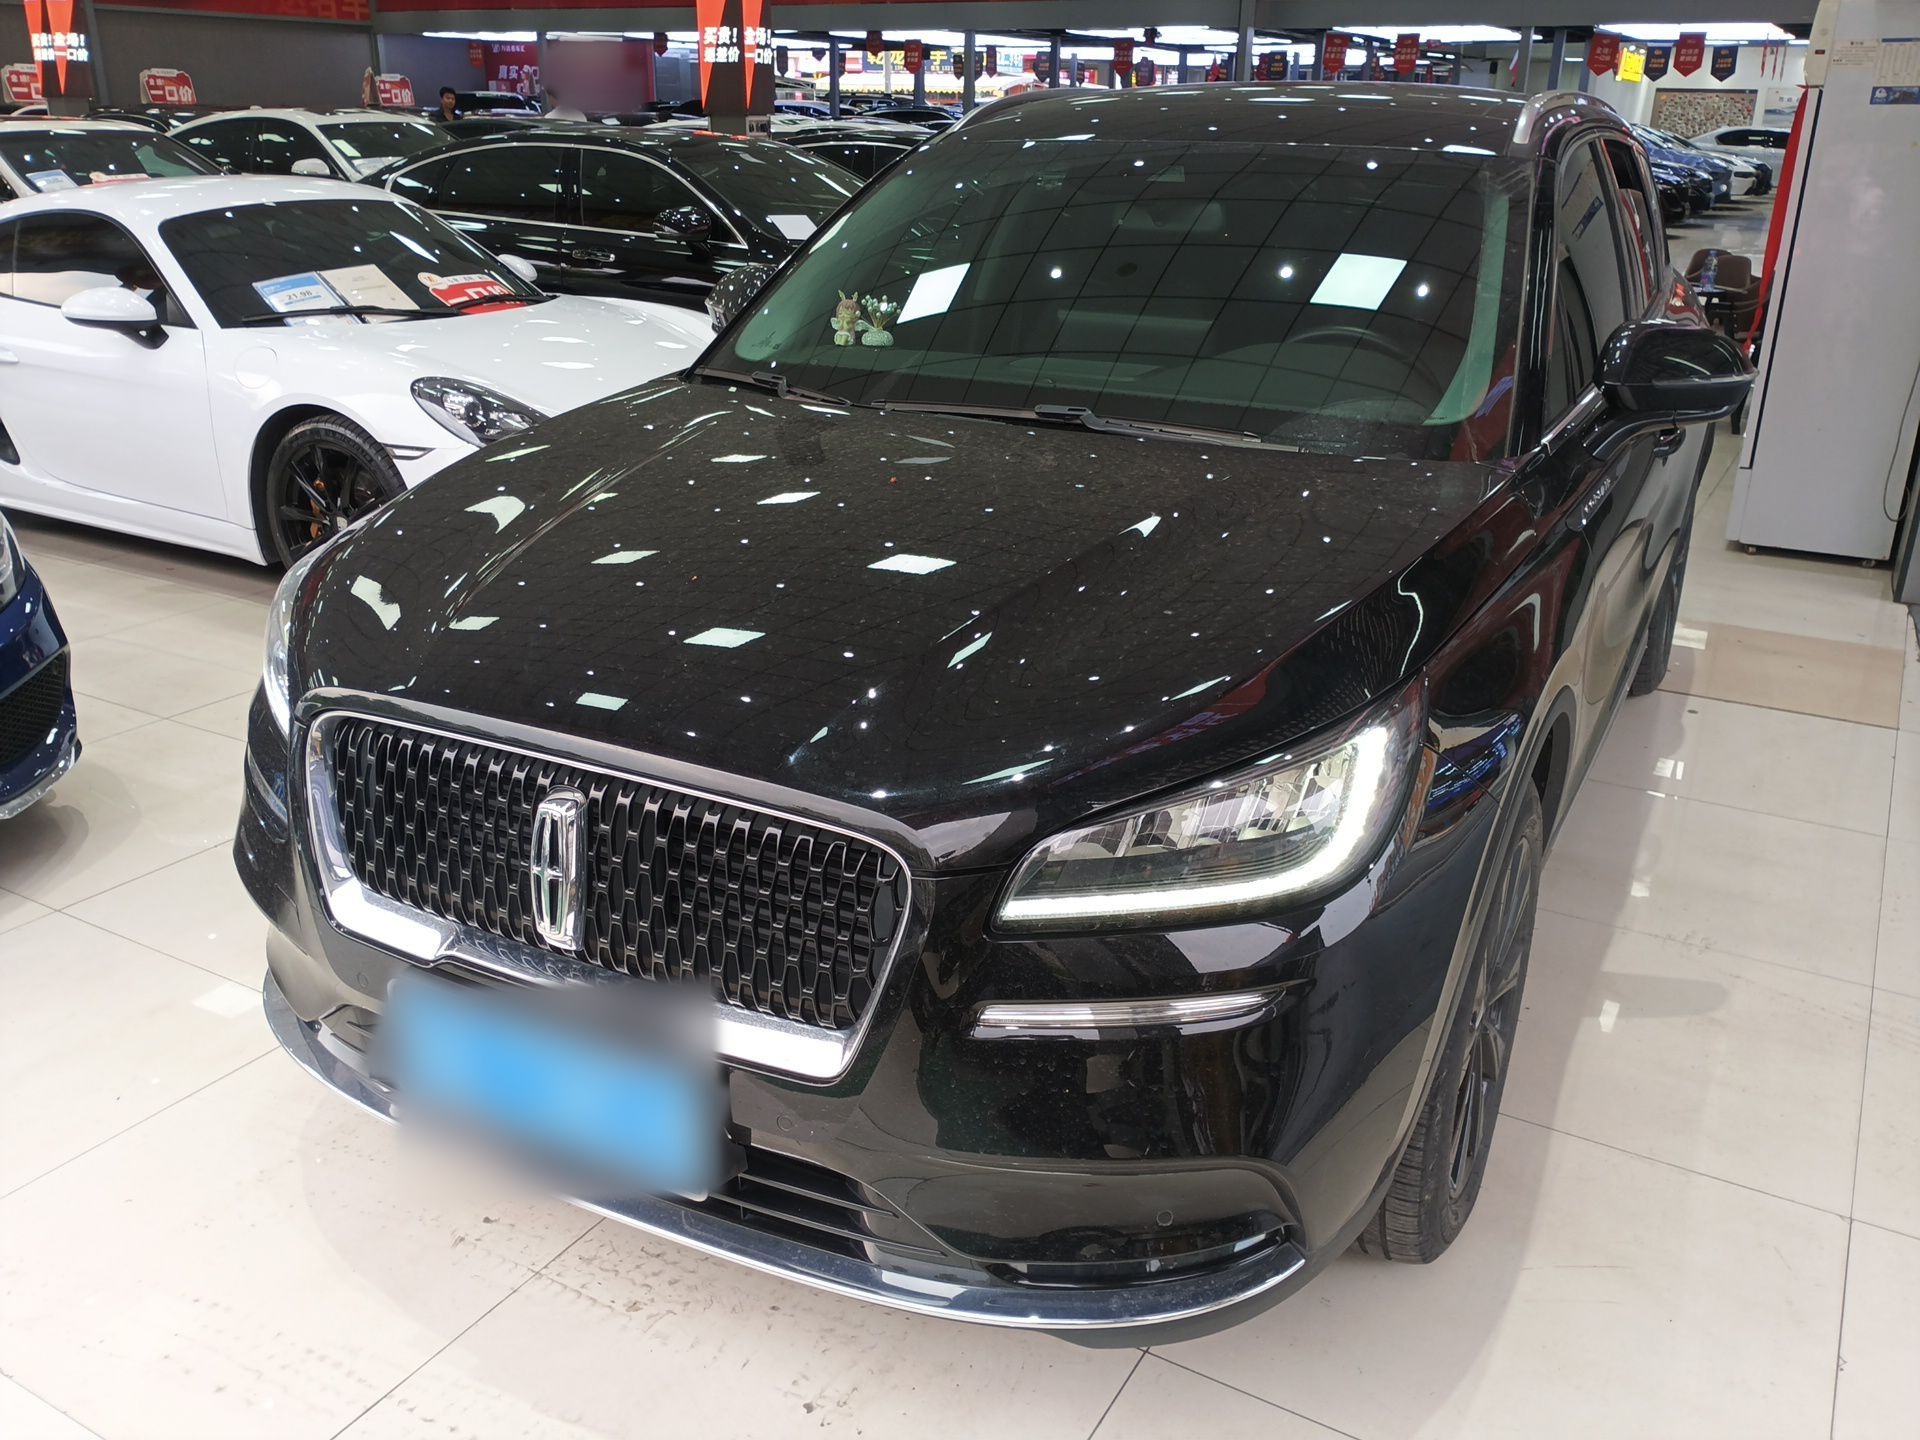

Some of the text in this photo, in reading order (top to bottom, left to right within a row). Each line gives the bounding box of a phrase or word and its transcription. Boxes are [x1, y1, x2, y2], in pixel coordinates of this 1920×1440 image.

[54, 48, 88, 61] 一口价
[744, 48, 773, 65] 一口价
[150, 85, 191, 104] 一口价
[381, 88, 411, 104] 一口价
